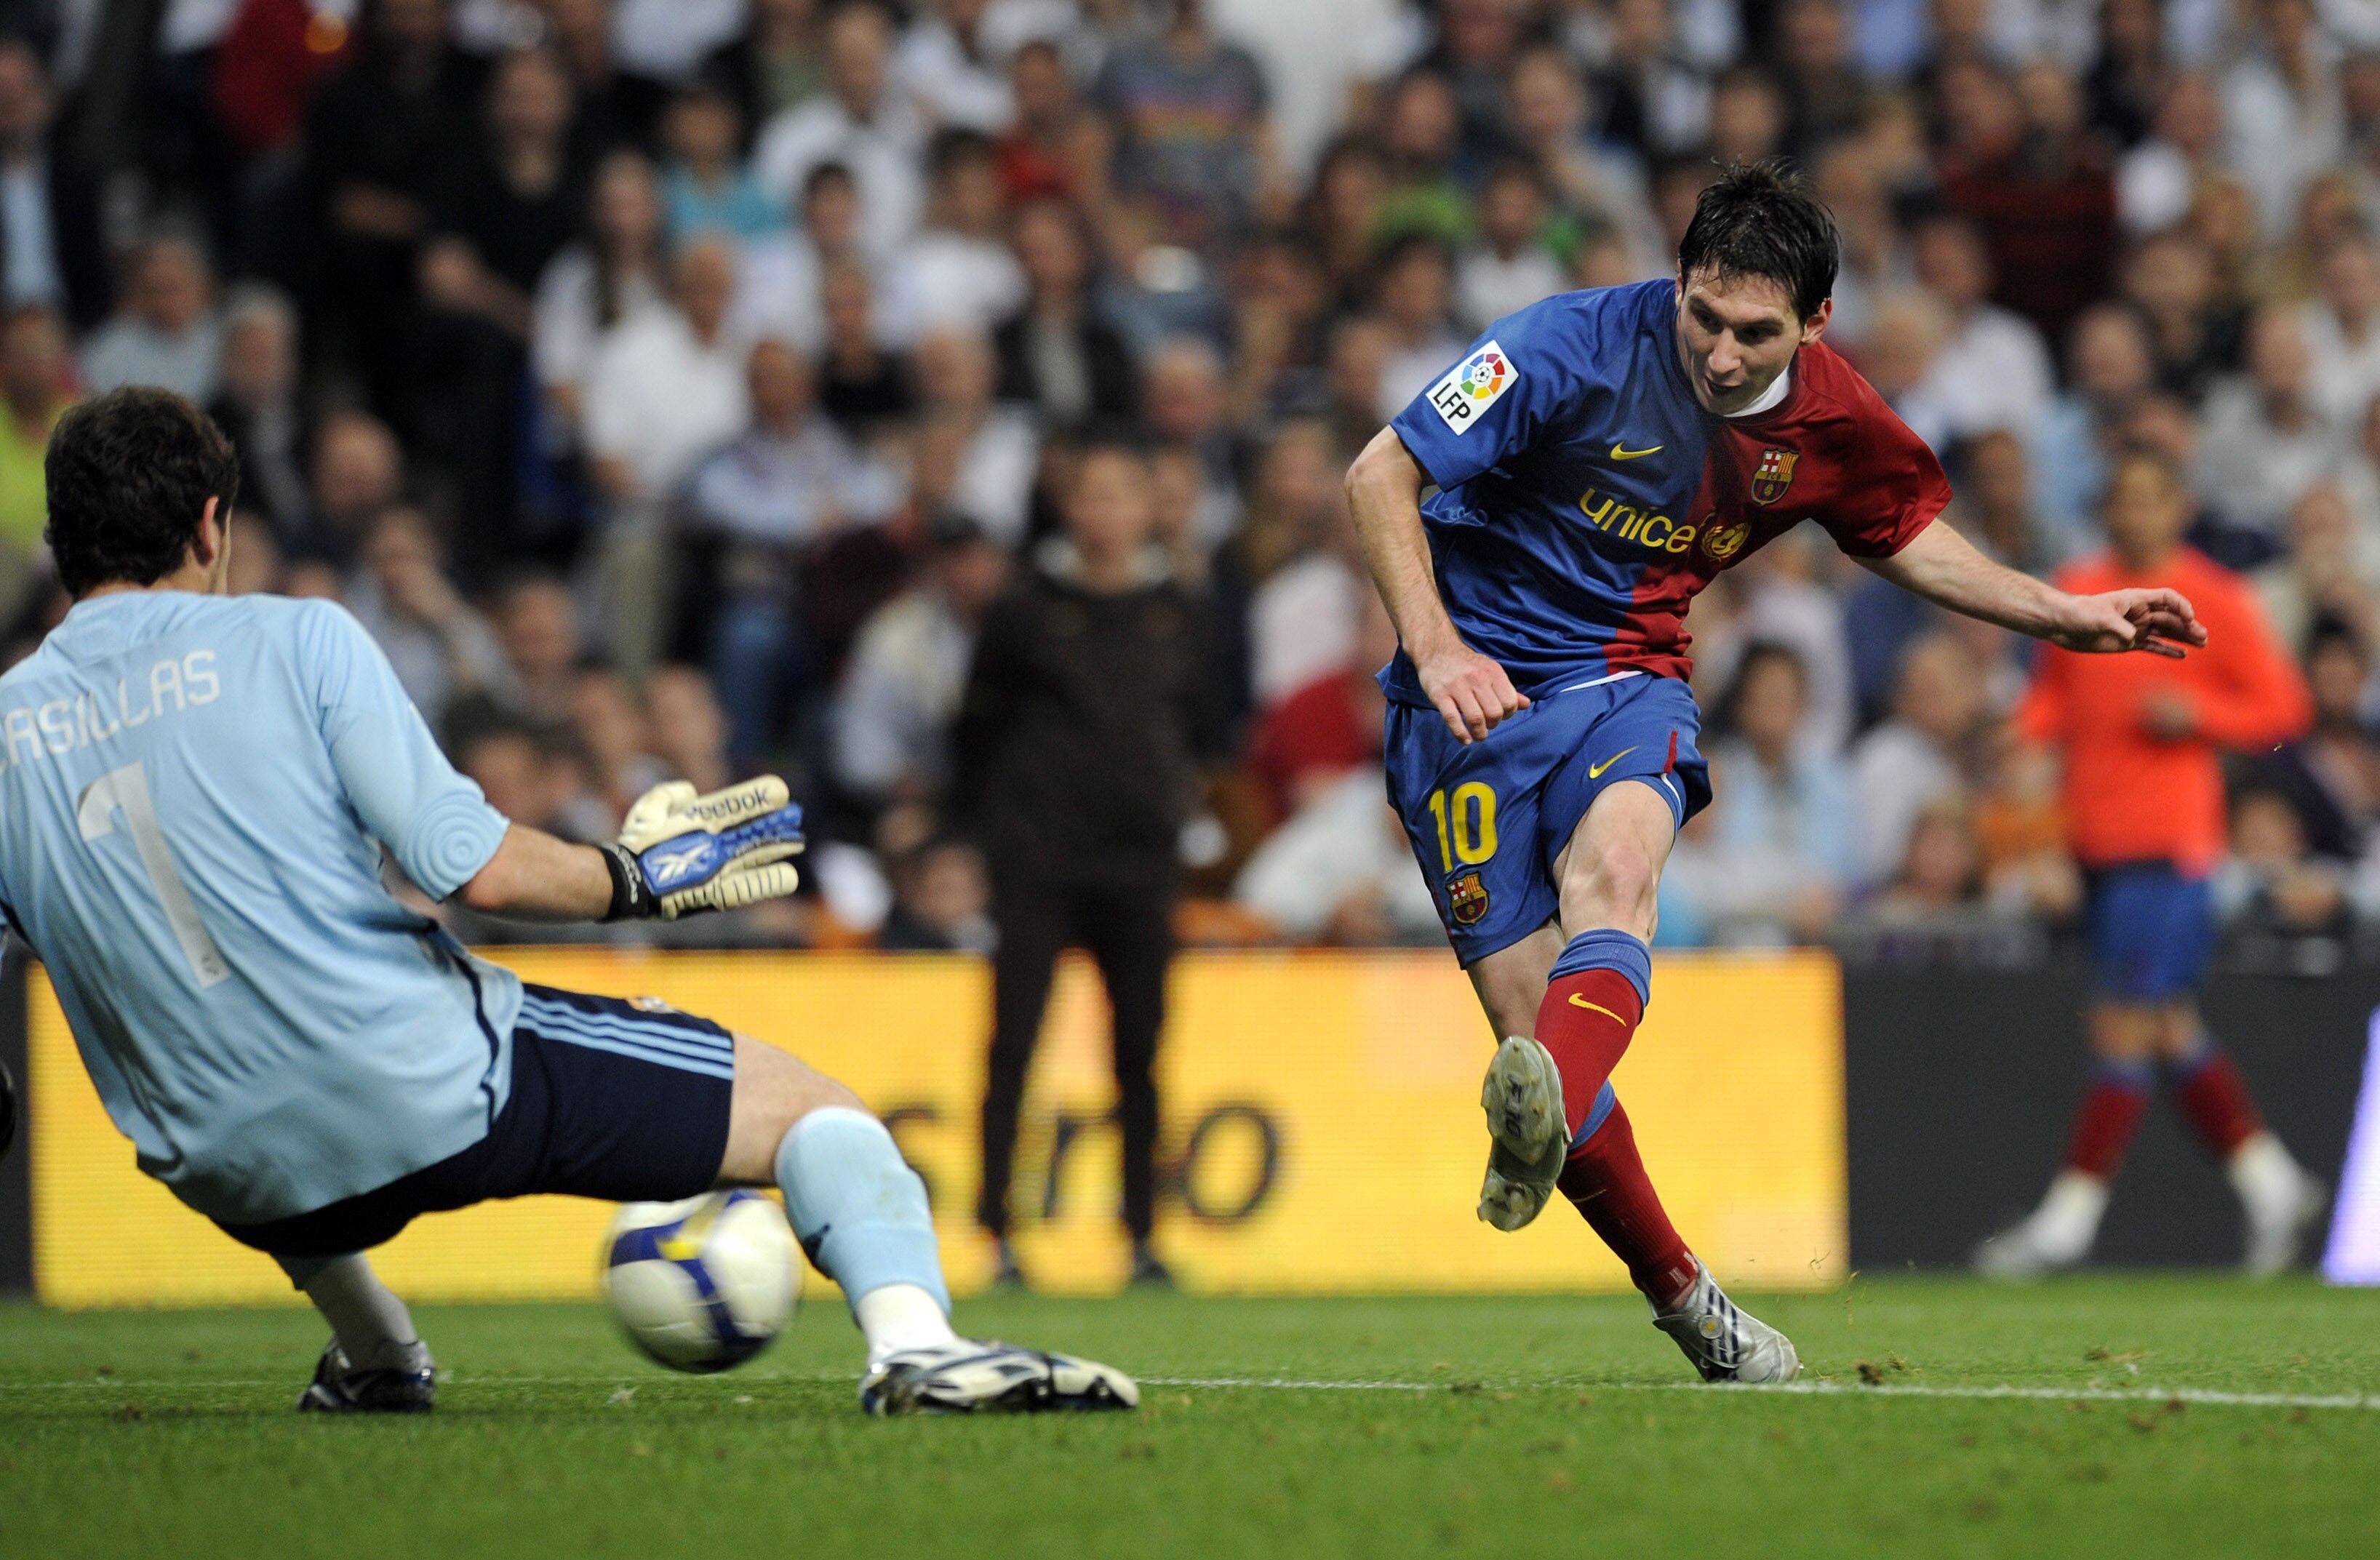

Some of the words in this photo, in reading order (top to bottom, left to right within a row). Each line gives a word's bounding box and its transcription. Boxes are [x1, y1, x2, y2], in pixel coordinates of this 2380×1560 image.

[1432, 382, 1471, 420] LFP
[1578, 488, 1697, 553] unice
[0, 649, 220, 775] ASILLAS
[1429, 782, 1498, 872] 10
[78, 760, 231, 990] 1
